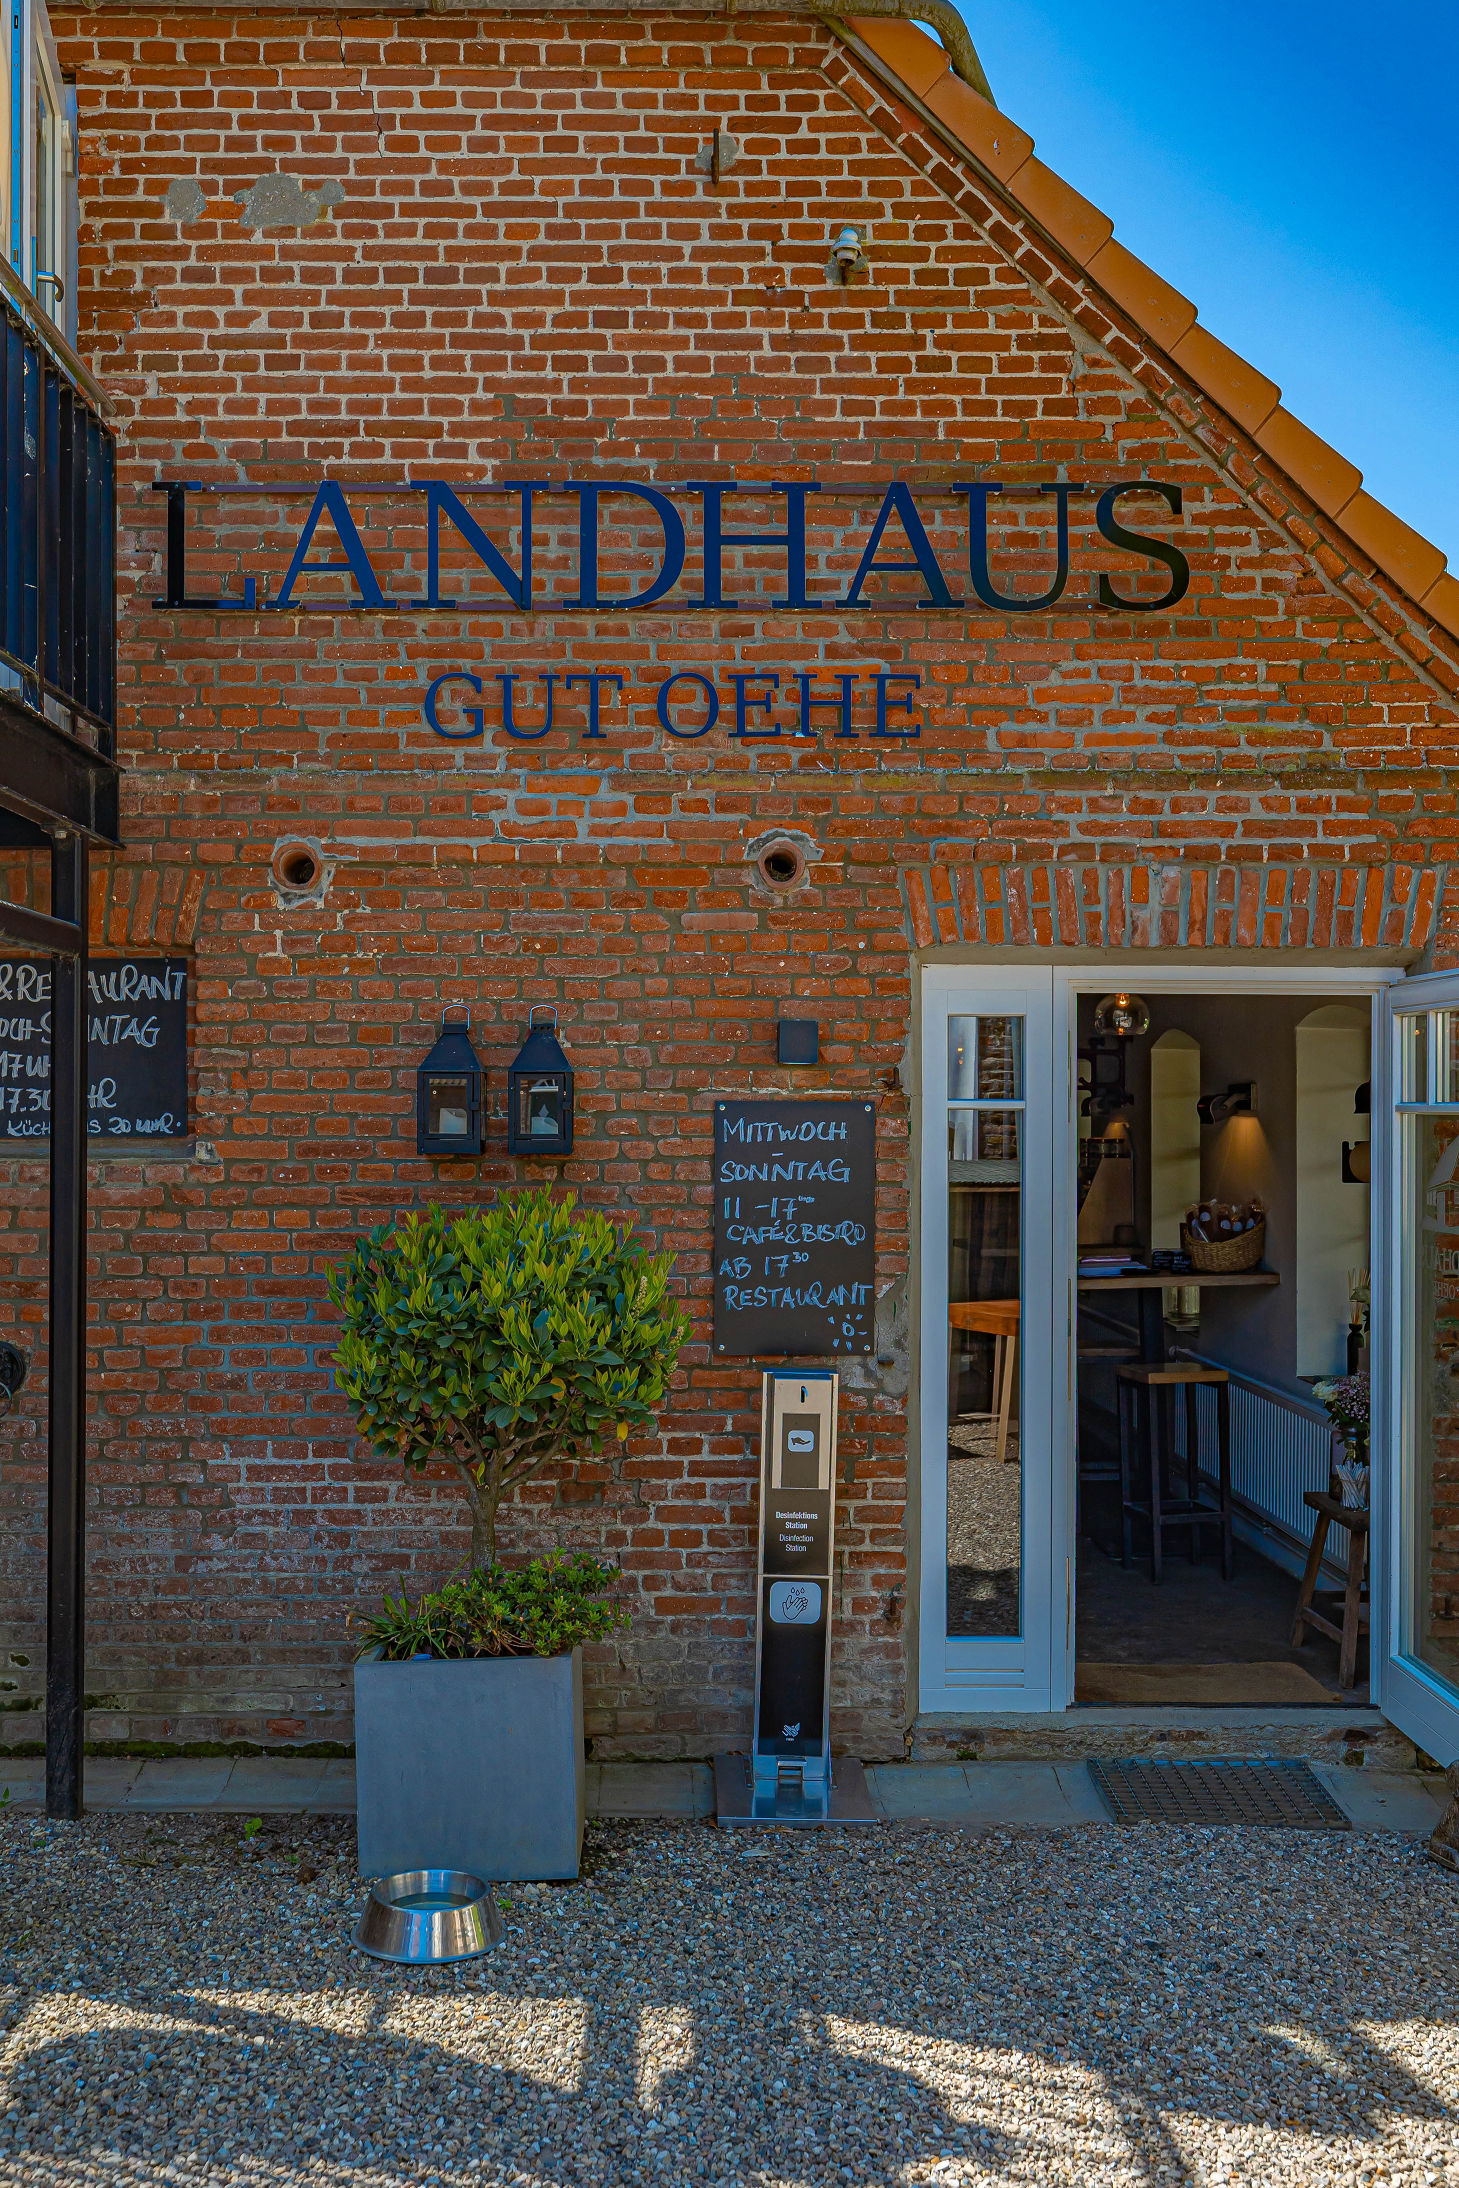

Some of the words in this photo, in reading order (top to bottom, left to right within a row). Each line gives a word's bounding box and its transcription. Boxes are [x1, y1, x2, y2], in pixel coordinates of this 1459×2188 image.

[152, 480, 1190, 612] LANDHAUS
[424, 672, 623, 740] GUT
[656, 672, 922, 740] OEHE
[723, 1117, 847, 1143] MITTWOCH
[720, 1158, 850, 1183] SONNTAG
[719, 1256, 752, 1280] AB
[723, 1281, 873, 1311] RESTAURANT
[775, 1511, 819, 1520] Desinfektions
[785, 1521, 808, 1529] Station
[779, 1533, 814, 1542] Disinfection
[785, 1543, 807, 1552] Station
